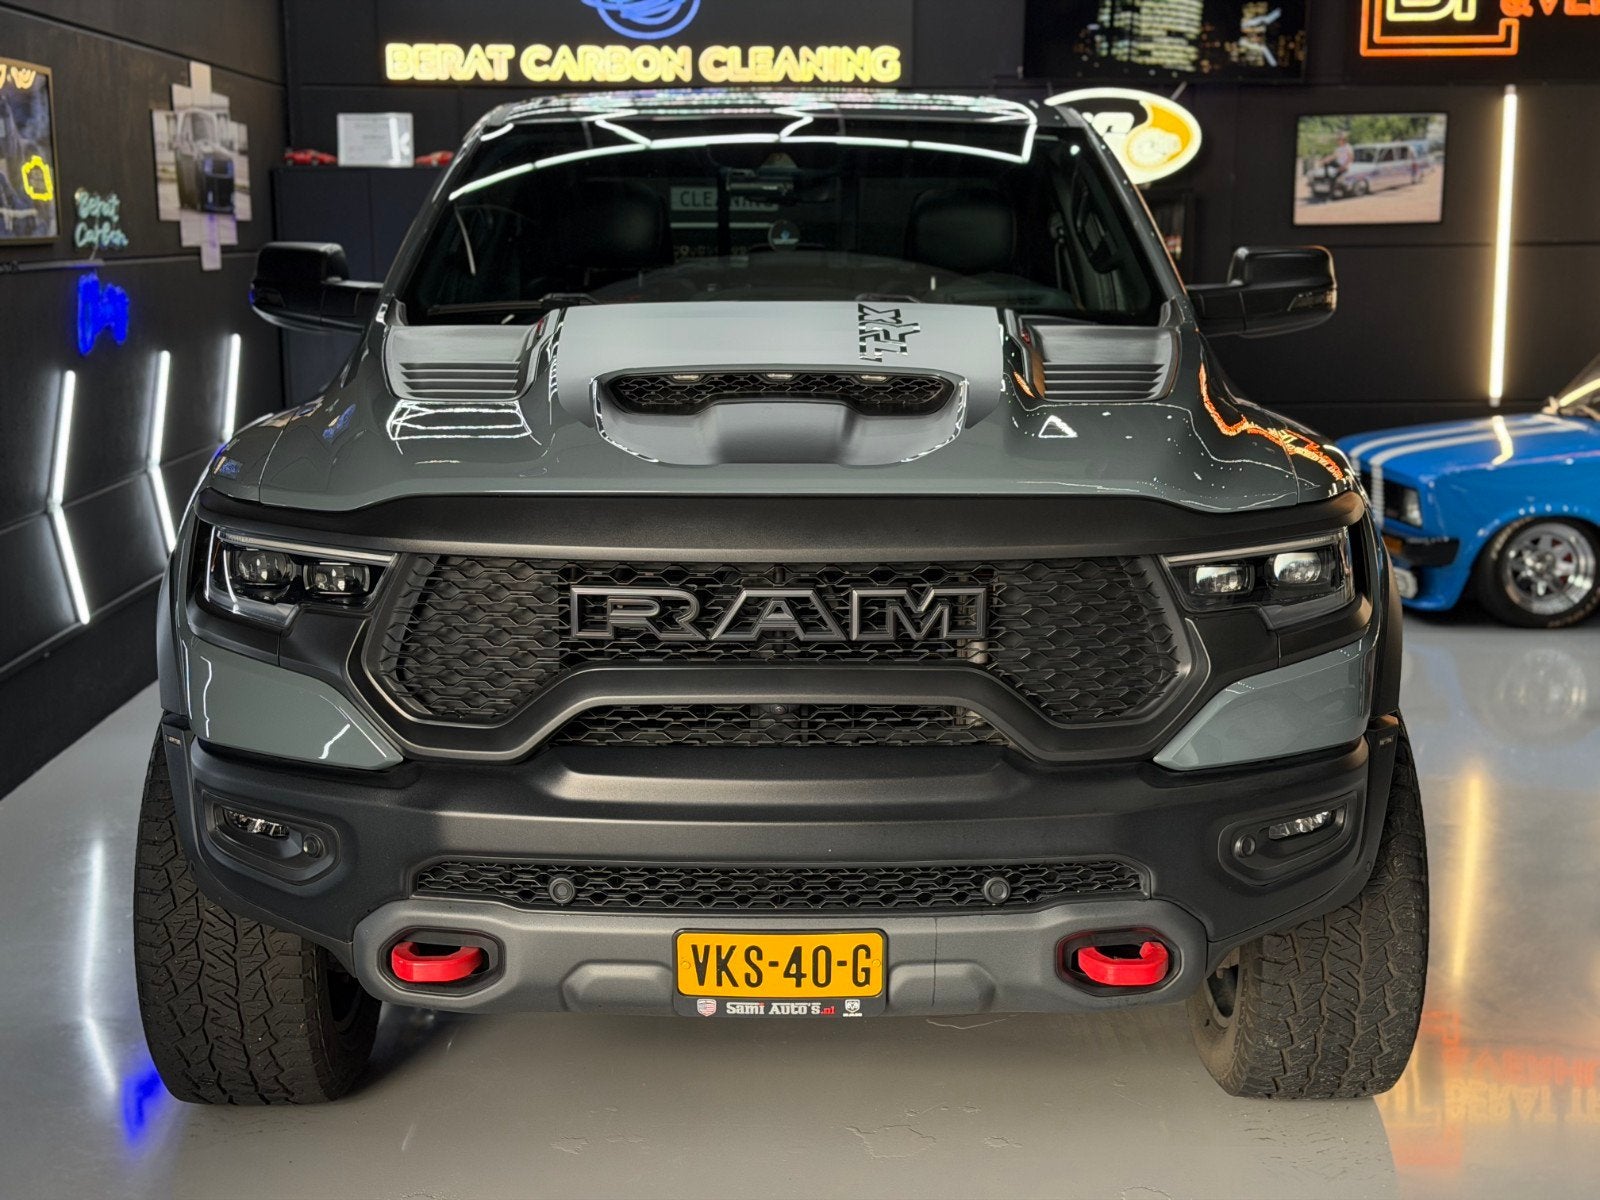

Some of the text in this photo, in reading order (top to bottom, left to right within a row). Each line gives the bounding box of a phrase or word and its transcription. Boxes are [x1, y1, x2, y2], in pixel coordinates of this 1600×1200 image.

[385, 43, 901, 83] BERAT CARBON CLEANING
[857, 303, 921, 362] TRX
[570, 586, 988, 641] RAM
[691, 944, 872, 988] VKS-40-G
[726, 1001, 765, 1015] Sami
